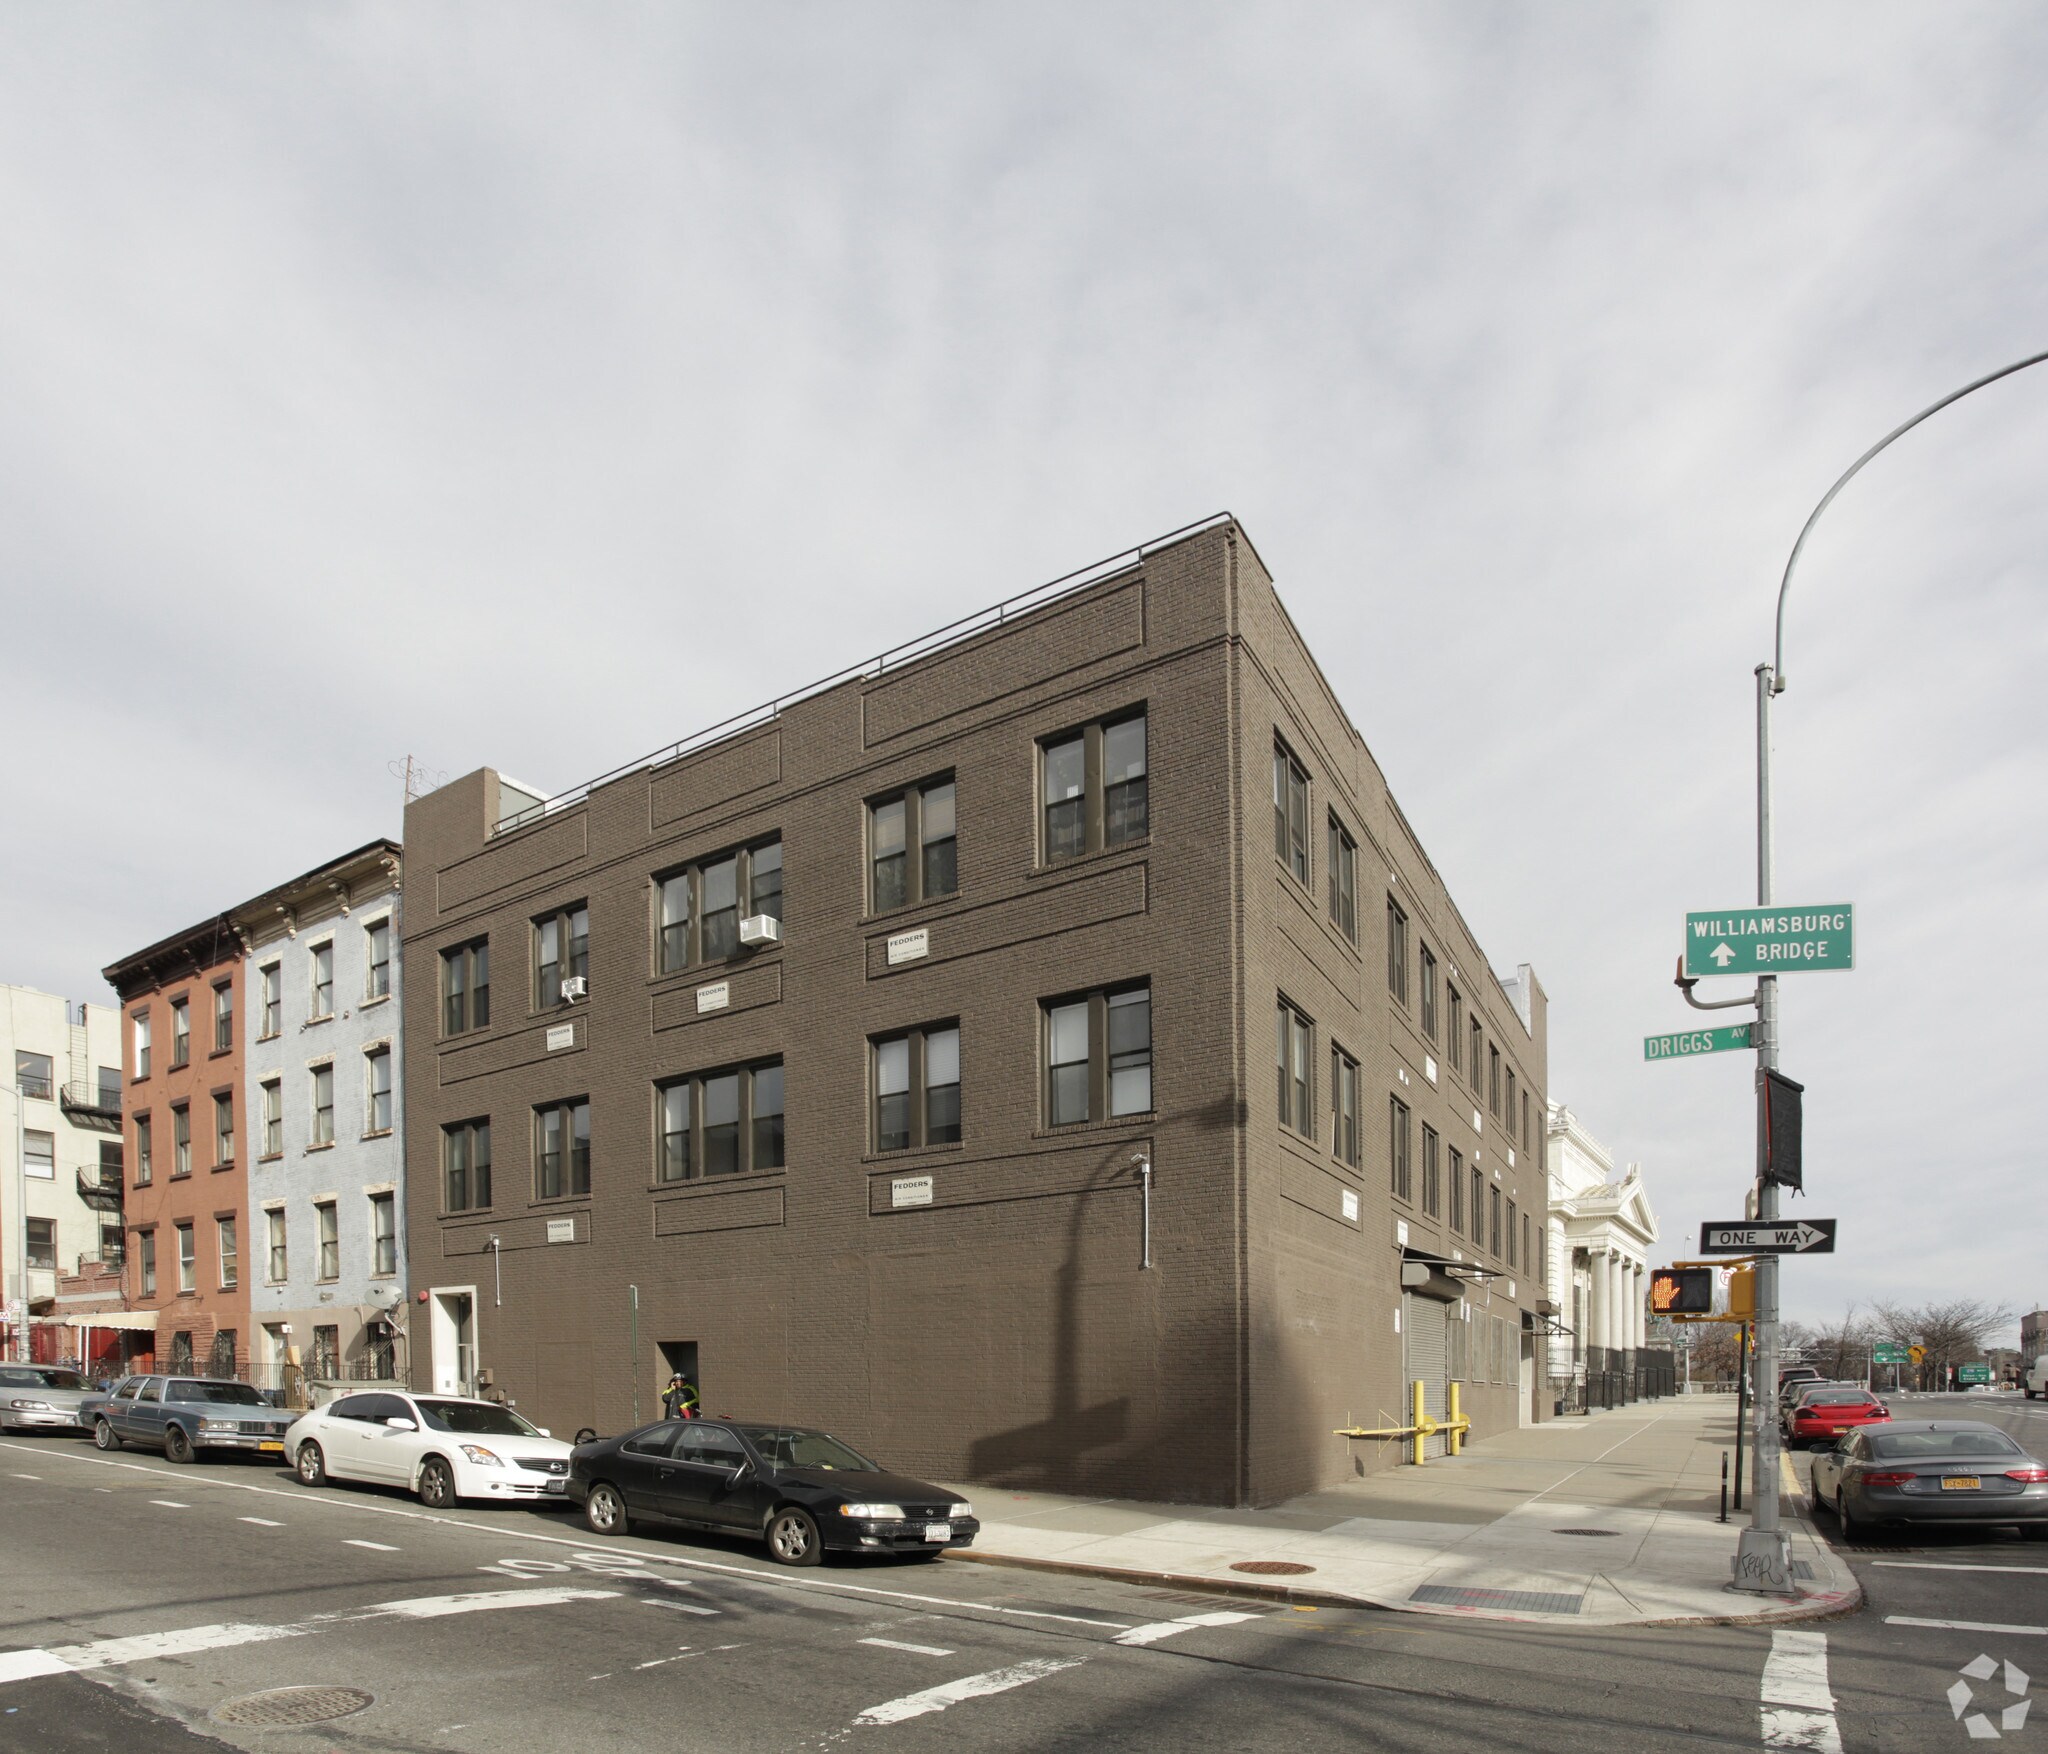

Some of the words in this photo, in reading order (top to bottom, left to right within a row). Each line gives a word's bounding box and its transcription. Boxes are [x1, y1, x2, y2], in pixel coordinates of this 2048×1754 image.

[1693, 914, 1845, 938] WILLIAMSBURG
[889, 933, 925, 947] FEDDERS
[1756, 941, 1829, 960] BRIDGE
[698, 986, 726, 998] FEDDERS
[1648, 1032, 1714, 1058] DRIGGS
[1731, 1027, 1746, 1039] AV
[894, 1180, 929, 1190] FEDDERS
[1720, 1231, 1757, 1245] ONE
[1774, 1230, 1815, 1244] WAY
